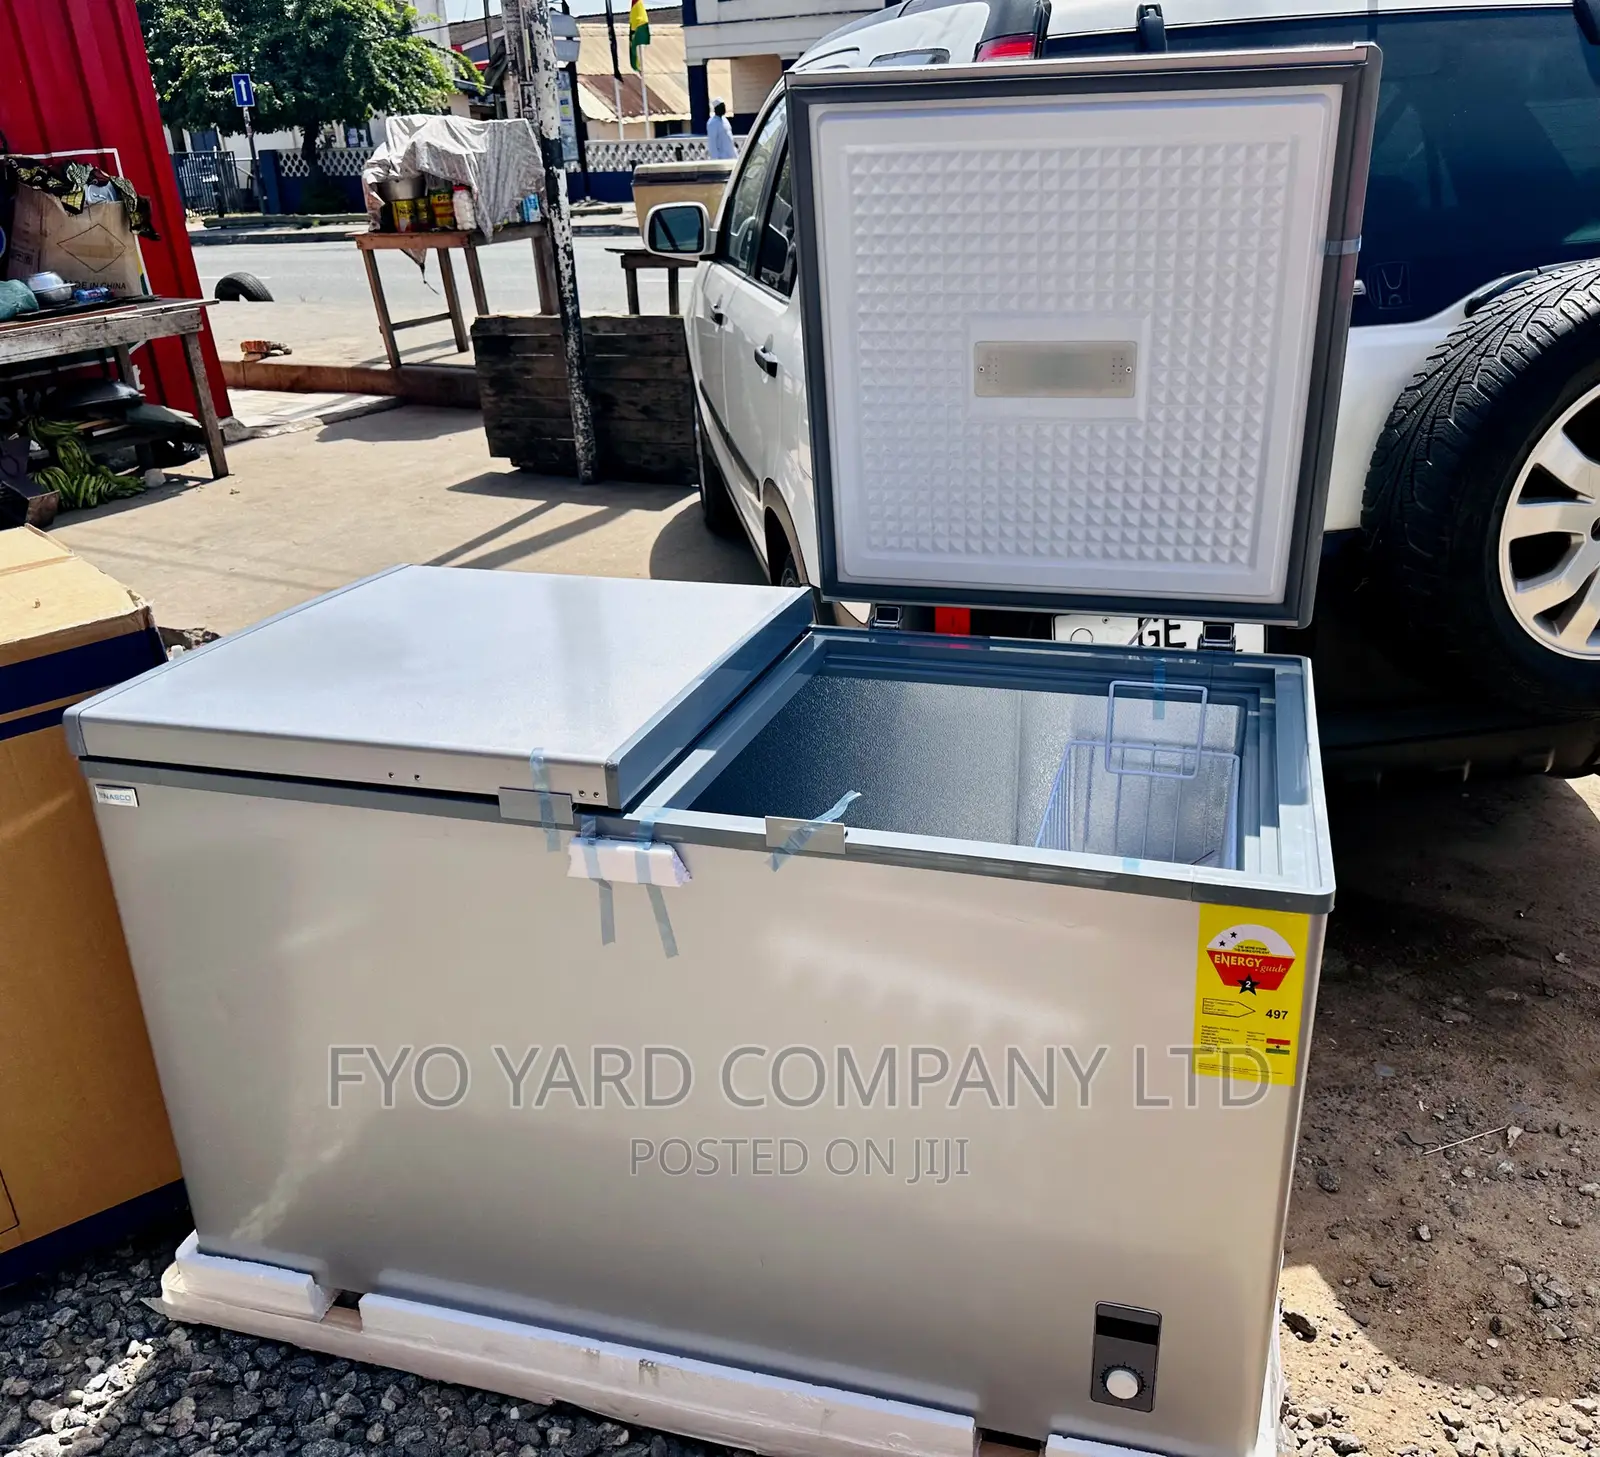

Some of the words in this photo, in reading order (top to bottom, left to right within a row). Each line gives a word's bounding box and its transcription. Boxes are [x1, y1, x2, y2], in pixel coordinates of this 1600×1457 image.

[100, 281, 127, 290] CHINA
[1214, 952, 1263, 968] ENERGY
[1260, 963, 1287, 974] guide
[1245, 980, 1251, 988] 2
[1265, 1009, 1289, 1020] 497
